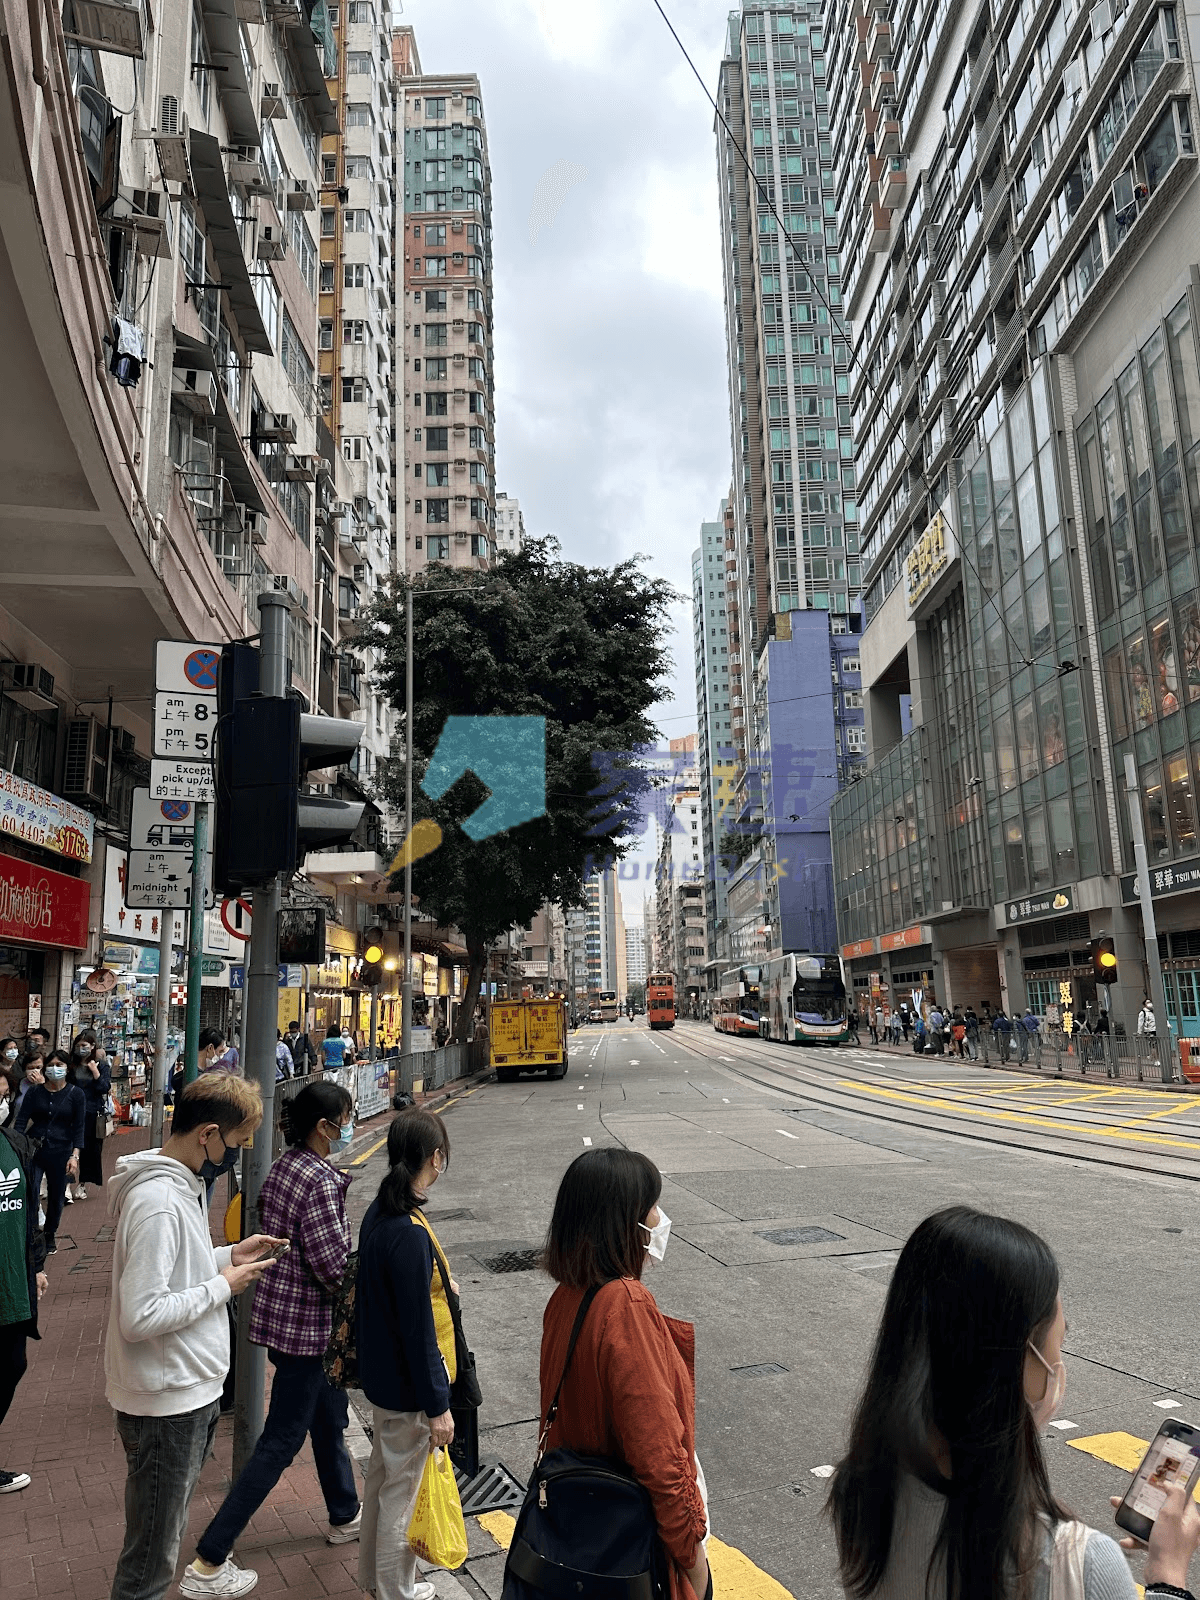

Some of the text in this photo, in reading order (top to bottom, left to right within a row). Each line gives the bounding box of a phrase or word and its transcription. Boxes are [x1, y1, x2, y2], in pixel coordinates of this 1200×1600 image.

[166, 699, 184, 707] am
[161, 709, 190, 722] 上午
[194, 703, 208, 721] 8
[166, 728, 184, 737] pm
[161, 738, 189, 751] 下午
[194, 733, 208, 751] 5
[176, 765, 211, 776] Except
[162, 774, 184, 784] pick
[149, 853, 165, 861] am
[144, 862, 169, 874] 上午
[1154, 868, 1174, 891] 翠華
[1175, 871, 1191, 884] TSUI
[132, 883, 178, 893] midnight
[138, 894, 168, 905] 午夜
[1059, 981, 1074, 1039] 翠華
